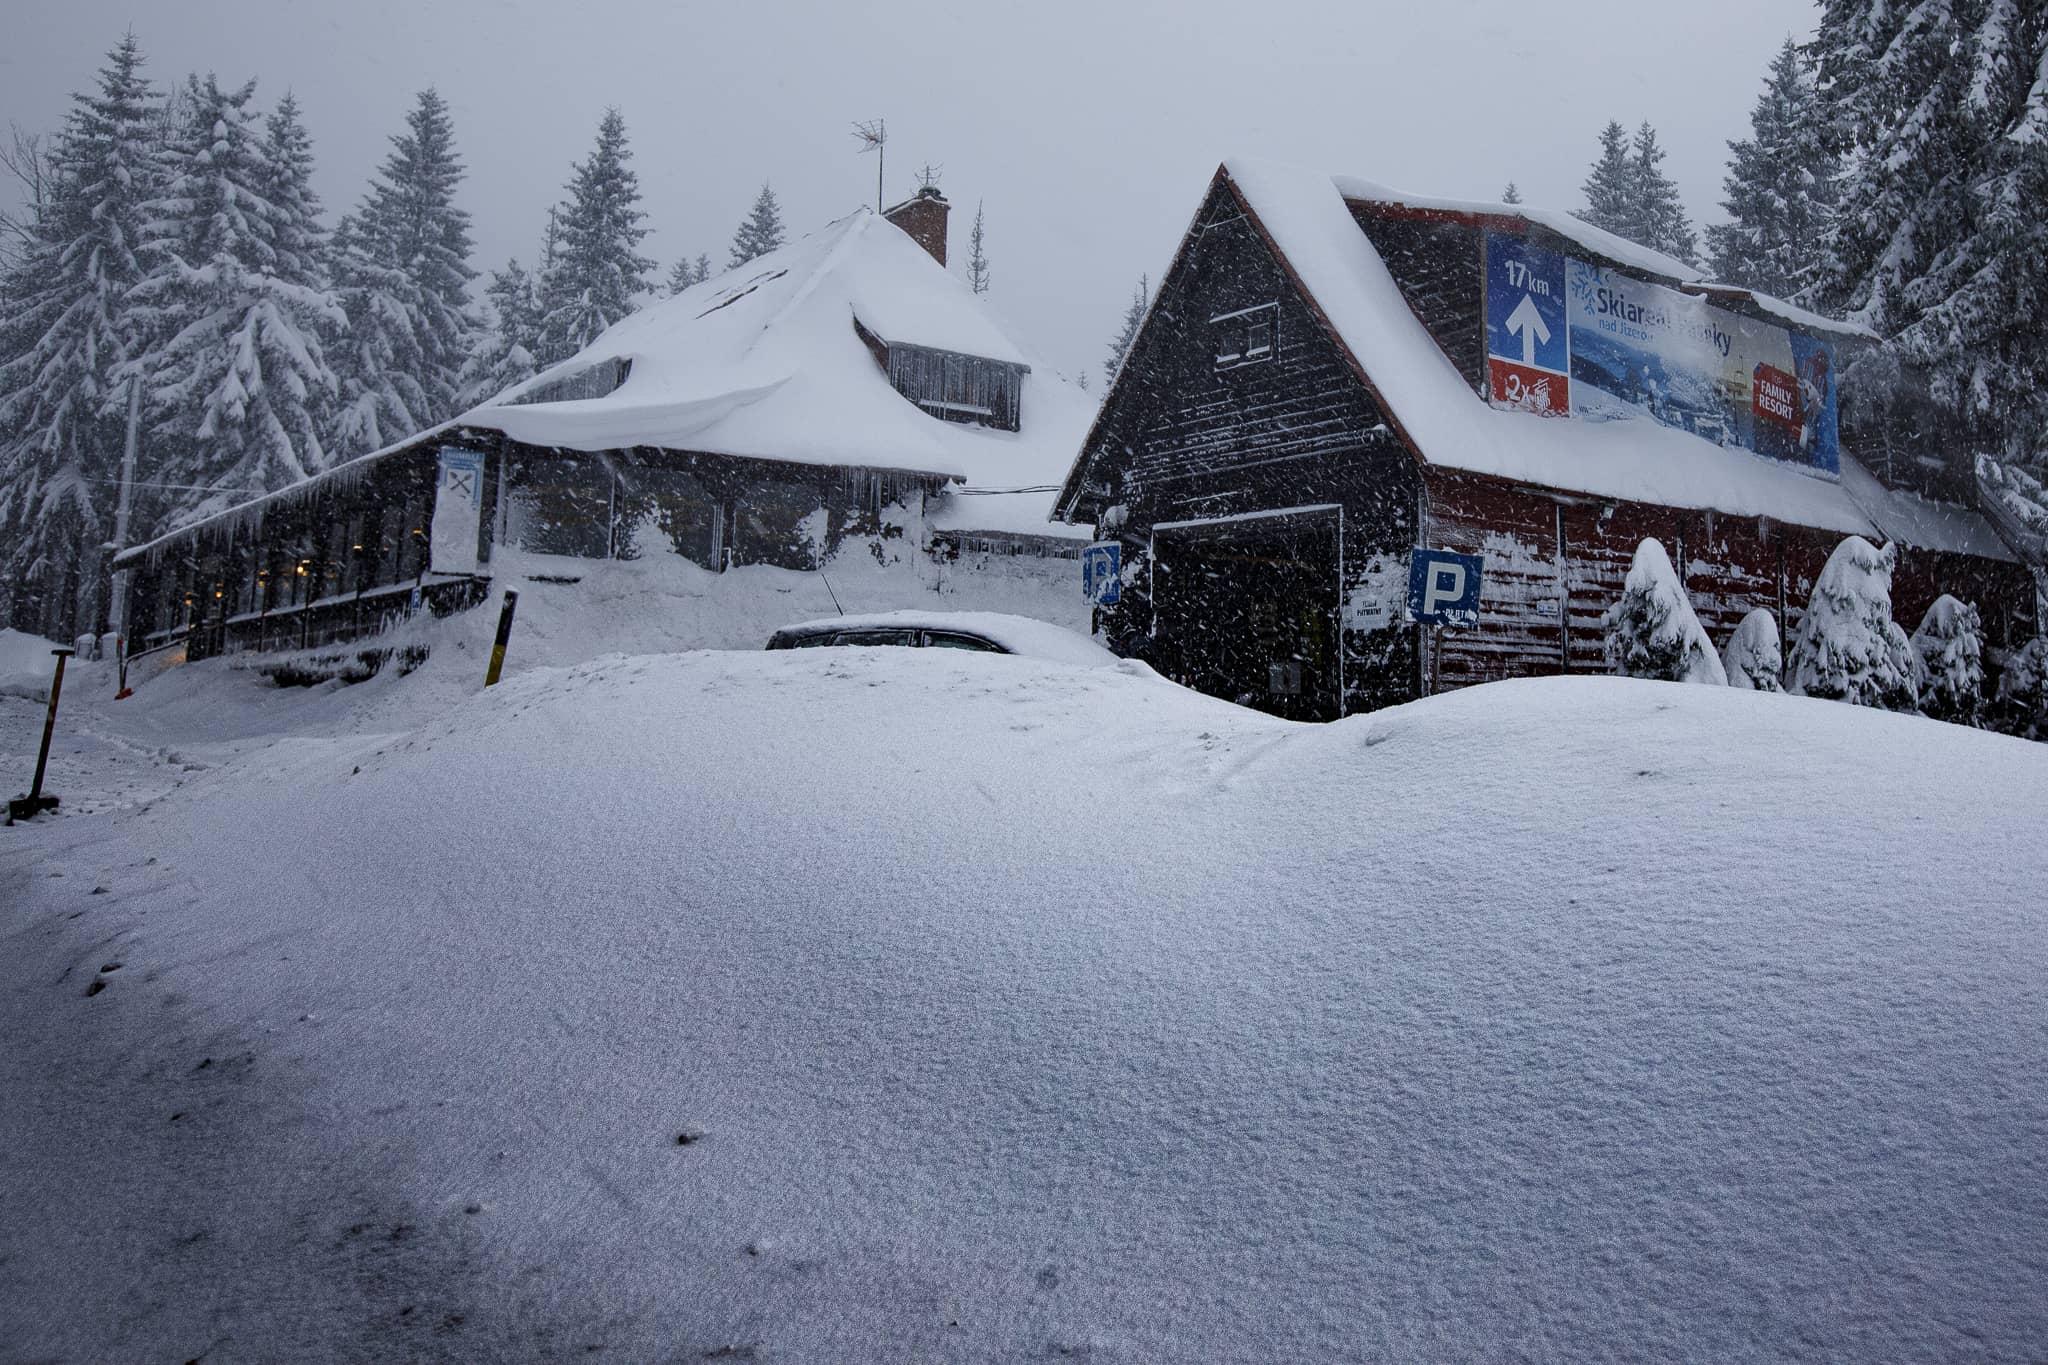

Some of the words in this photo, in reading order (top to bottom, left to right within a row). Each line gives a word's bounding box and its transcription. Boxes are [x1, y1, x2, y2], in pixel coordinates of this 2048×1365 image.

[1599, 318, 1617, 333] nad
[1761, 379, 1792, 405] FAMILY
[1759, 393, 1794, 420] RESORT
[1091, 552, 1112, 594] P
[1424, 561, 1466, 614] P
